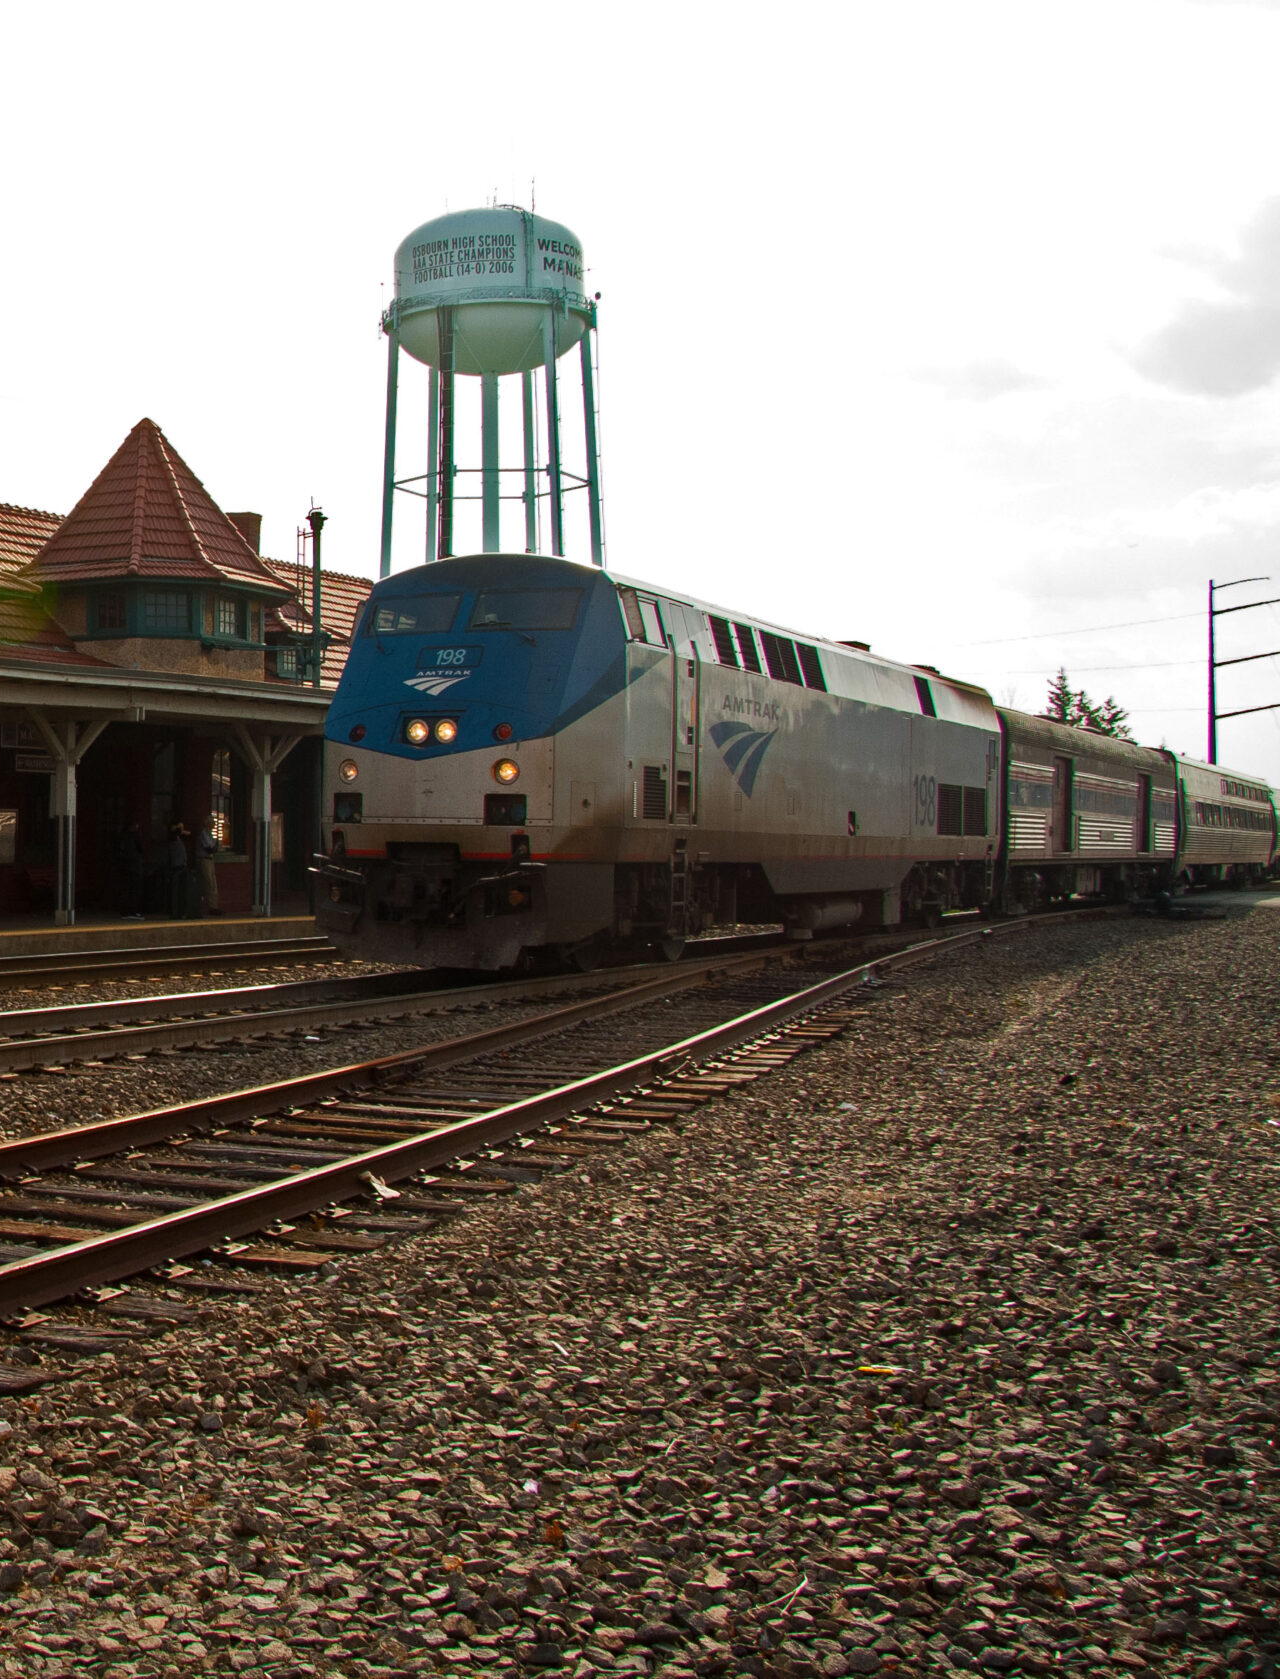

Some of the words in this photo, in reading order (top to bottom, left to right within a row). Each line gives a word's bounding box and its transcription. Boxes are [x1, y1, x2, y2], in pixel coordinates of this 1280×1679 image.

[412, 238, 449, 258] OSBOURN
[452, 236, 475, 249] HIGH
[478, 234, 517, 247] SCHOOL
[428, 250, 455, 266] STATE
[457, 247, 516, 262] CHAMPIONS
[414, 265, 454, 284] FOOTBALL
[456, 262, 486, 277] (14-0)
[489, 261, 514, 273] 2006
[436, 648, 466, 665] 198
[722, 694, 780, 720] AMTRAK
[912, 774, 936, 826] 198
